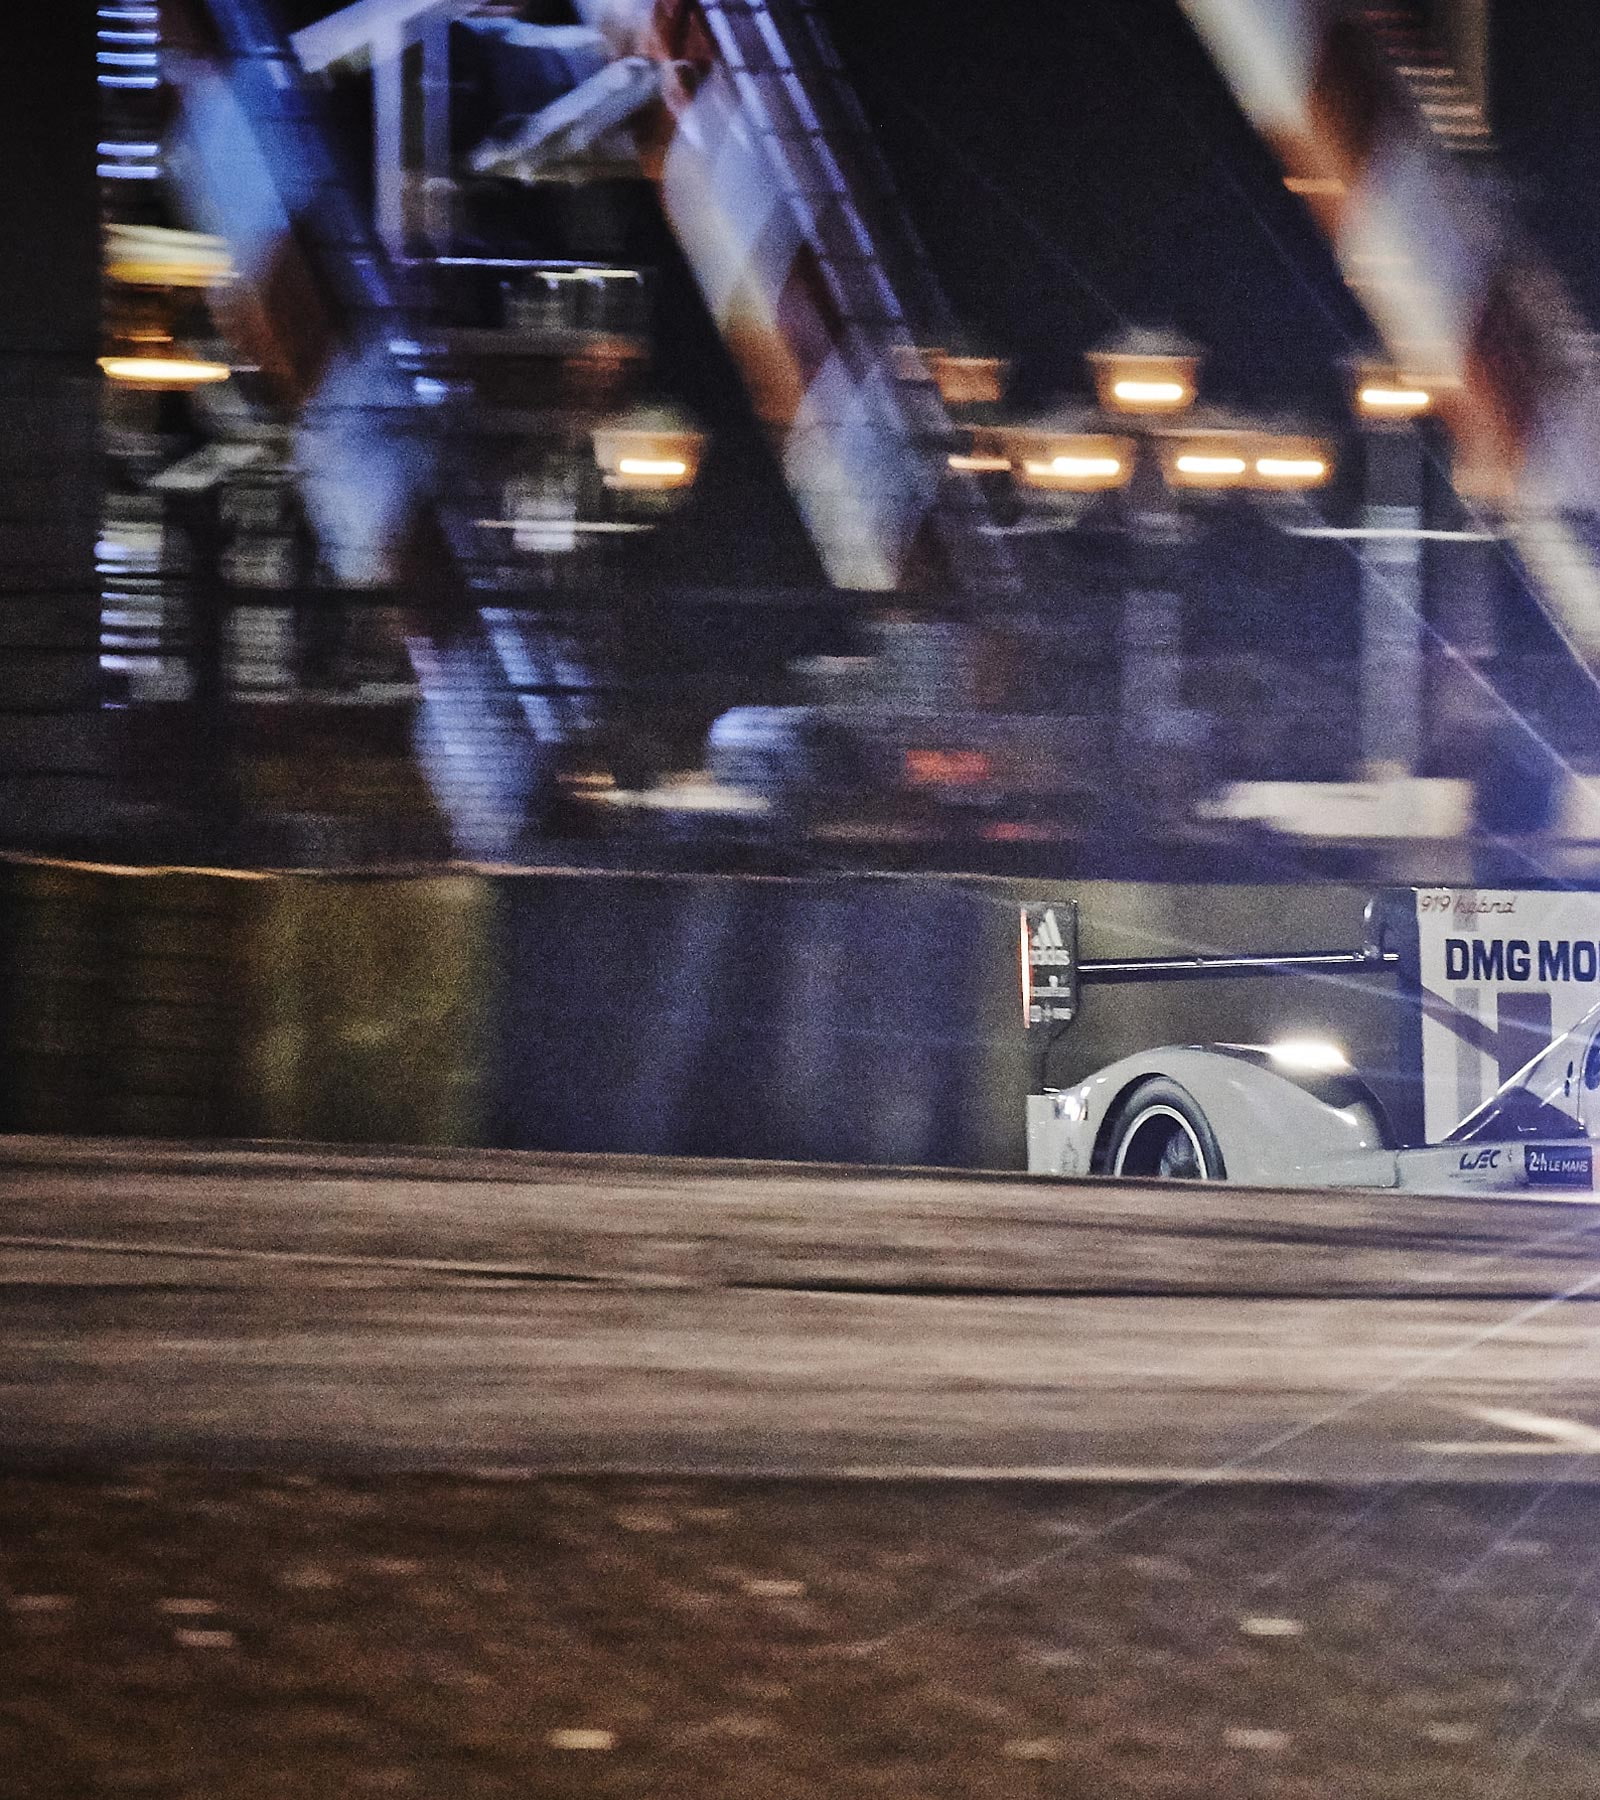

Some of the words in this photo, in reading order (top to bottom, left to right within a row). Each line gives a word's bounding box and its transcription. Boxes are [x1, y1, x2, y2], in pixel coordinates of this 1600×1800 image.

[1421, 895, 1451, 912] 919
[1445, 939, 1530, 981] DMG
[1459, 1150, 1501, 1170] WEC
[1549, 1160, 1561, 1172] LE
[1562, 1160, 1588, 1172] MANS
